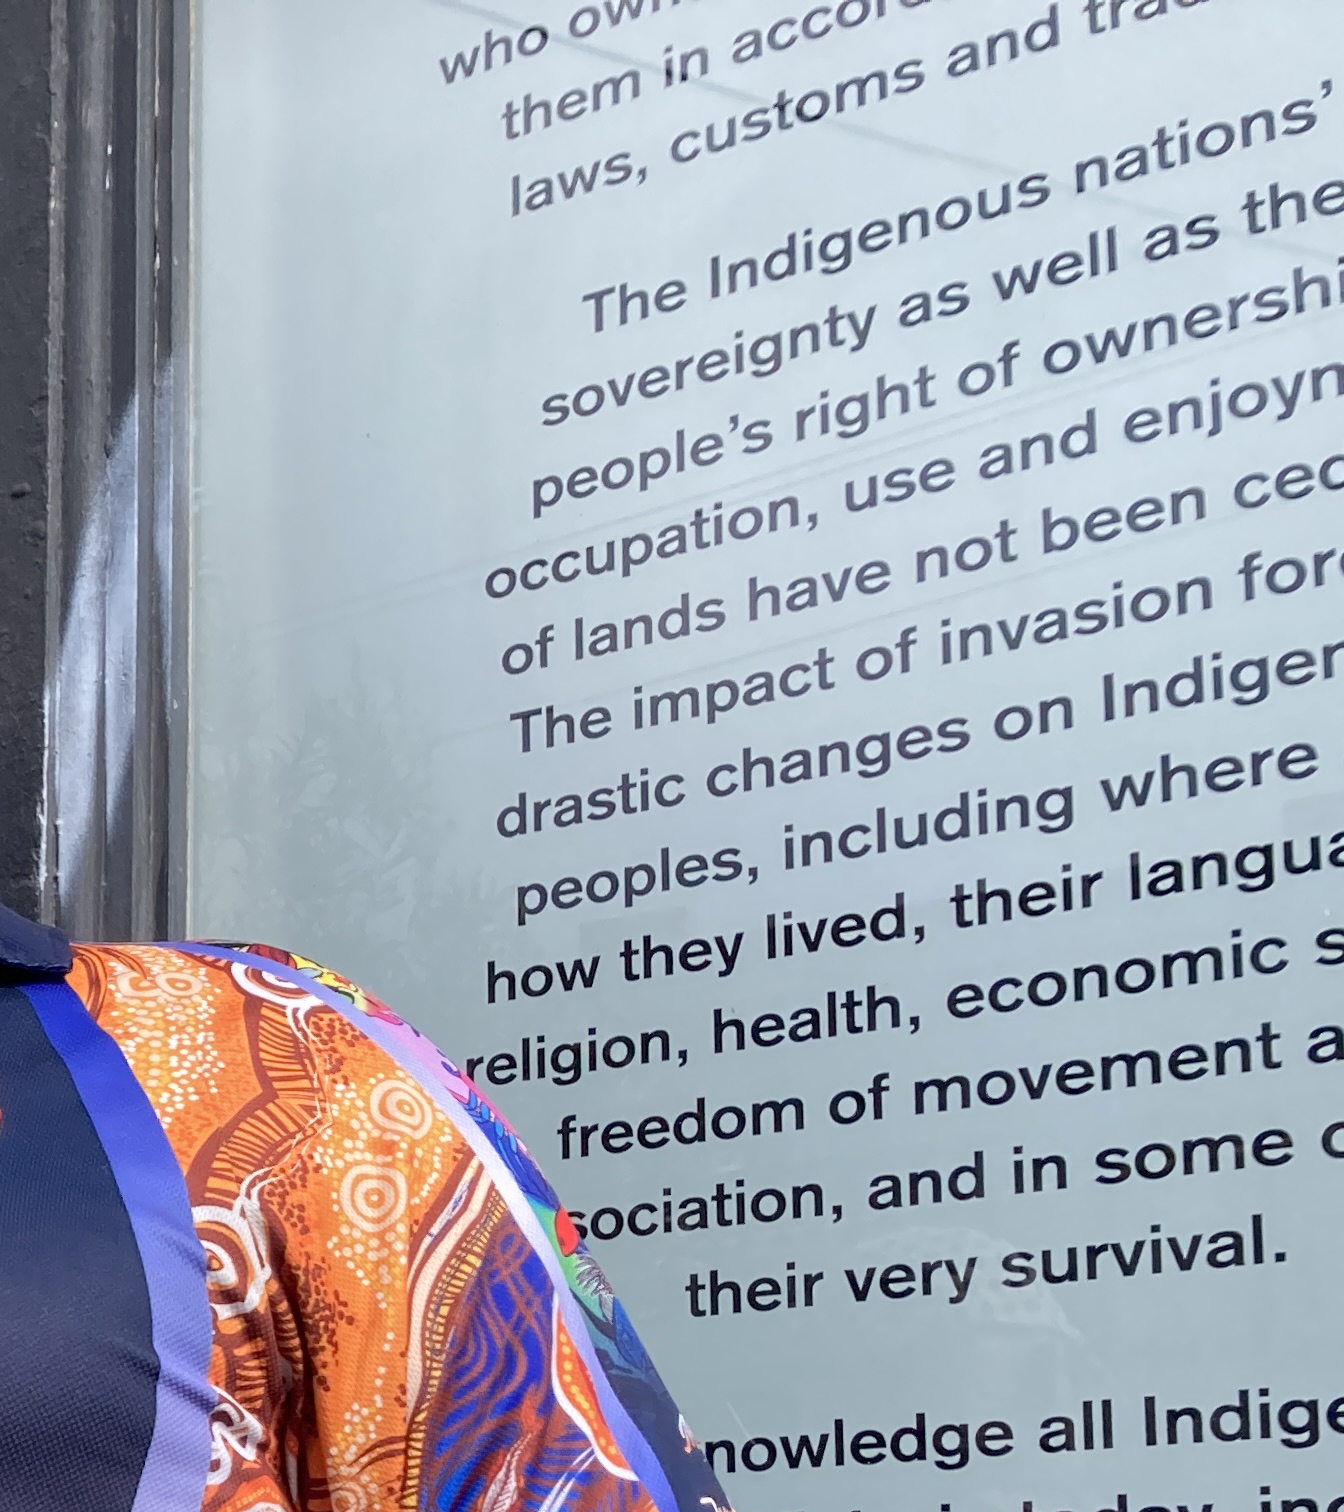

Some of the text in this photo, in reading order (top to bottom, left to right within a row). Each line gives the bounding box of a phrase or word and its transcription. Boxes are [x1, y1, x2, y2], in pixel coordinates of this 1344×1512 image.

[440, 26, 549, 84] who
[502, 0, 930, 139] them in acco
[513, 0, 1212, 216] laws, customs and tra
[543, 305, 877, 426] sovereignty
[899, 282, 970, 327] as
[992, 226, 1117, 301] well
[1144, 215, 1220, 261] as
[582, 280, 686, 332] The
[711, 174, 1050, 298] Indigenous
[797, 366, 936, 441] right
[958, 340, 1020, 396] of
[486, 496, 817, 598] occupation,
[846, 459, 955, 512] use
[979, 408, 1096, 479] and
[502, 624, 554, 674] of
[575, 593, 725, 660] lands
[749, 561, 890, 621] have
[917, 519, 1018, 583] not
[1042, 487, 1205, 554] been
[510, 548, 1344, 752] The impact of invasion for
[497, 768, 685, 837] drastic
[707, 718, 970, 797] changes
[994, 697, 1073, 741] on
[518, 743, 1318, 926] peoples, including where
[488, 955, 600, 1004] how
[620, 932, 744, 982] they
[767, 892, 924, 959] lived,
[950, 864, 1103, 928] their
[467, 1028, 687, 1086] religion,
[714, 985, 919, 1054] health,
[947, 929, 1288, 1019] economic
[557, 1097, 804, 1160] freedom
[829, 1072, 890, 1124] of
[915, 1022, 1282, 1115] movement
[869, 1151, 984, 1210] and
[1013, 1146, 1067, 1194] in
[1095, 1129, 1293, 1184] some
[685, 1214, 1286, 1317] their very survival.
[1039, 1399, 1113, 1453] all
